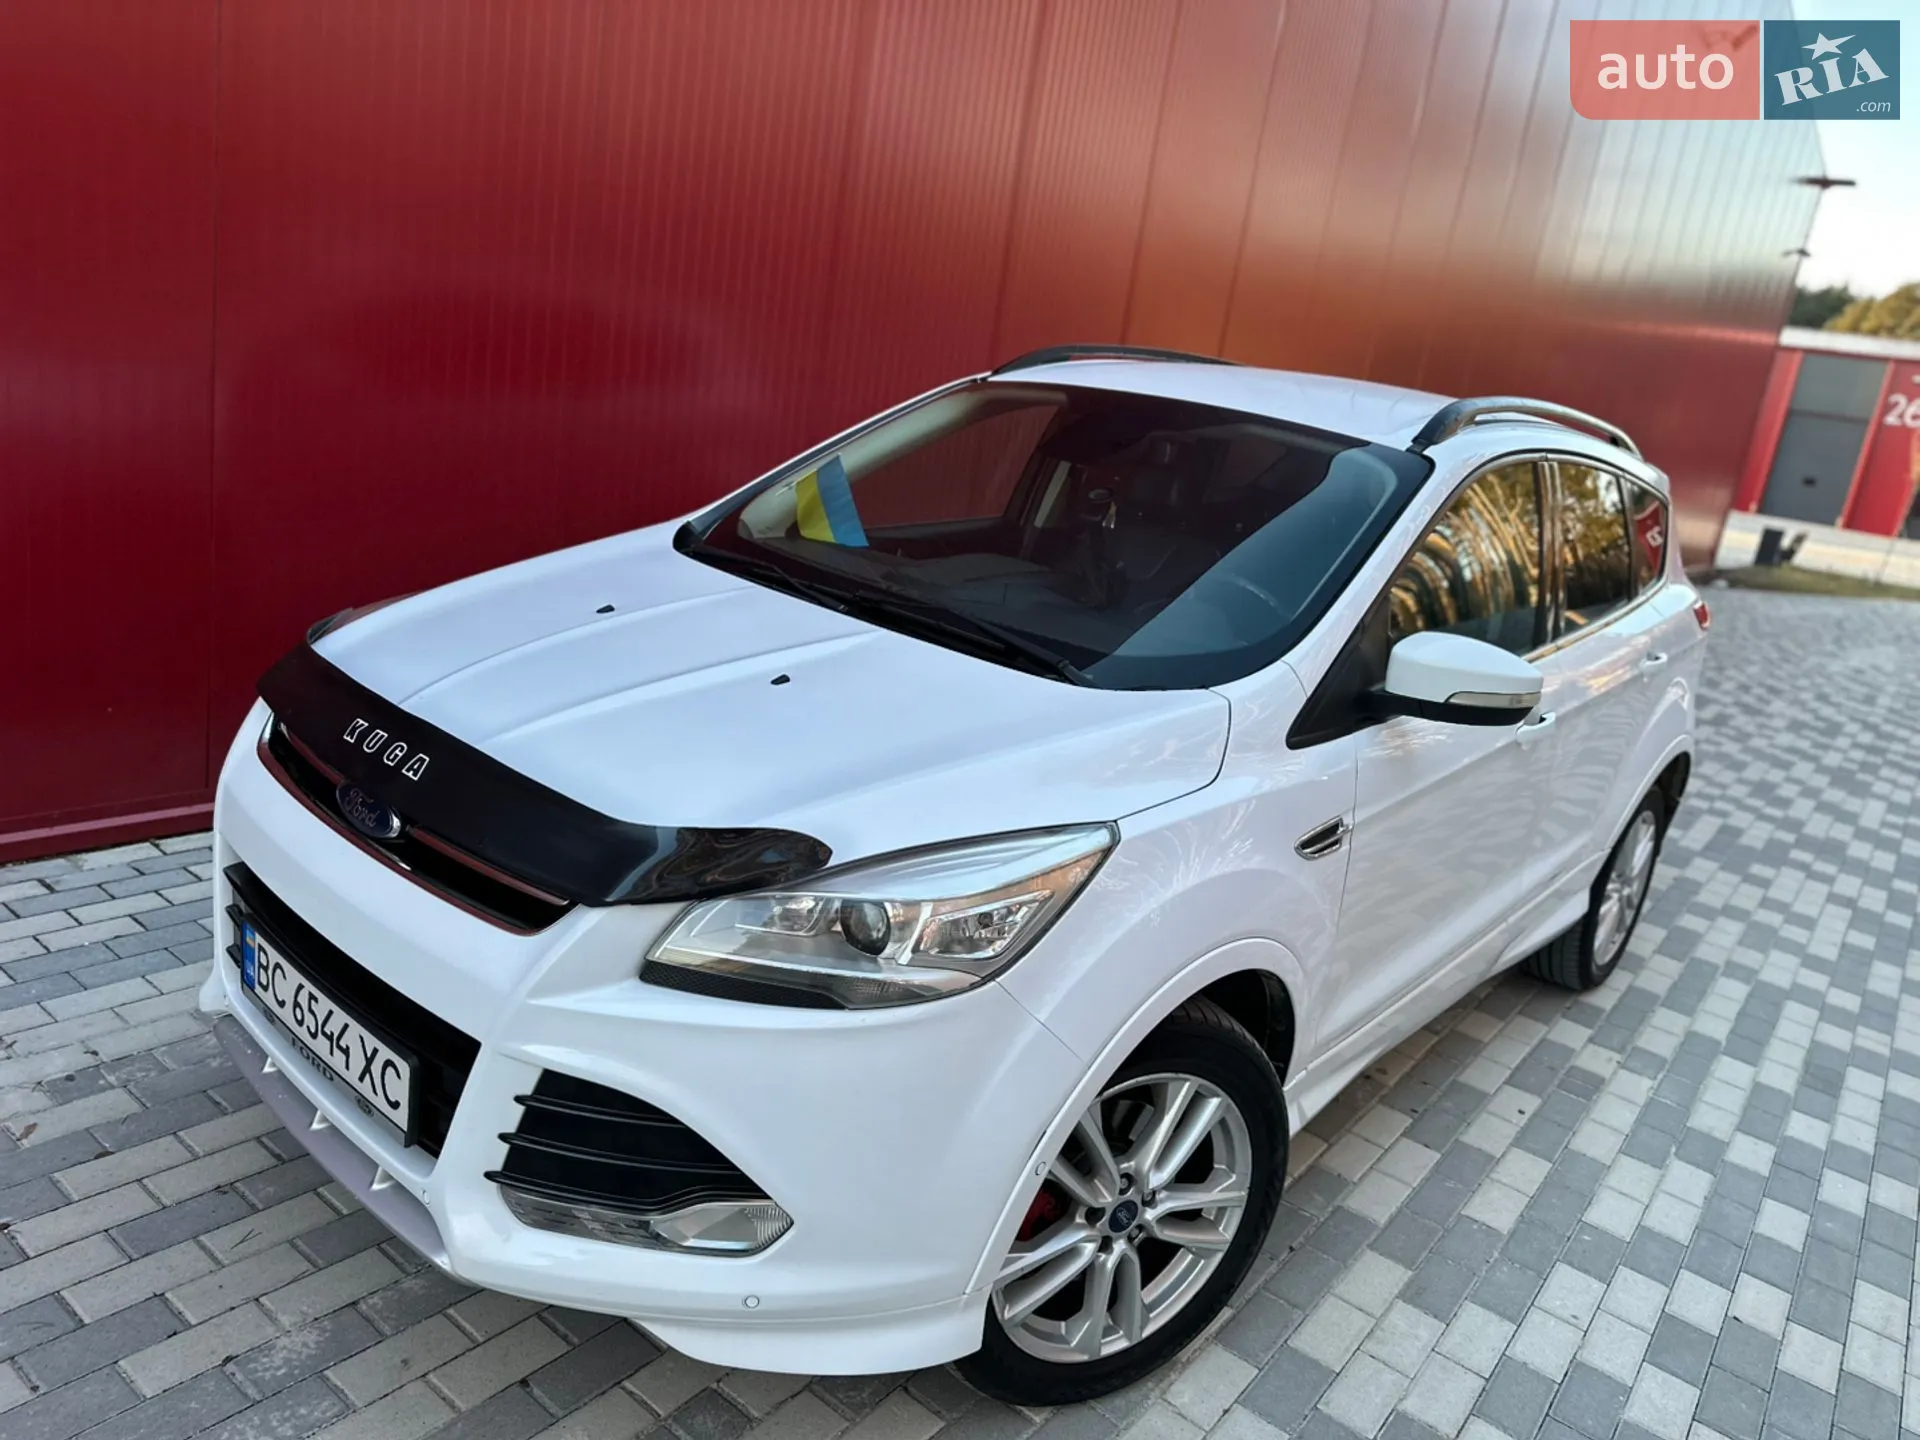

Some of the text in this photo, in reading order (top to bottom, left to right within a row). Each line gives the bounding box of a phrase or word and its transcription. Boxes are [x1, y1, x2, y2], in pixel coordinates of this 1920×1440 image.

[343, 718, 430, 781] KUGA
[344, 788, 380, 827] Ford
[257, 942, 402, 1111] BC 6544 XC
[291, 1035, 334, 1082] FORD
